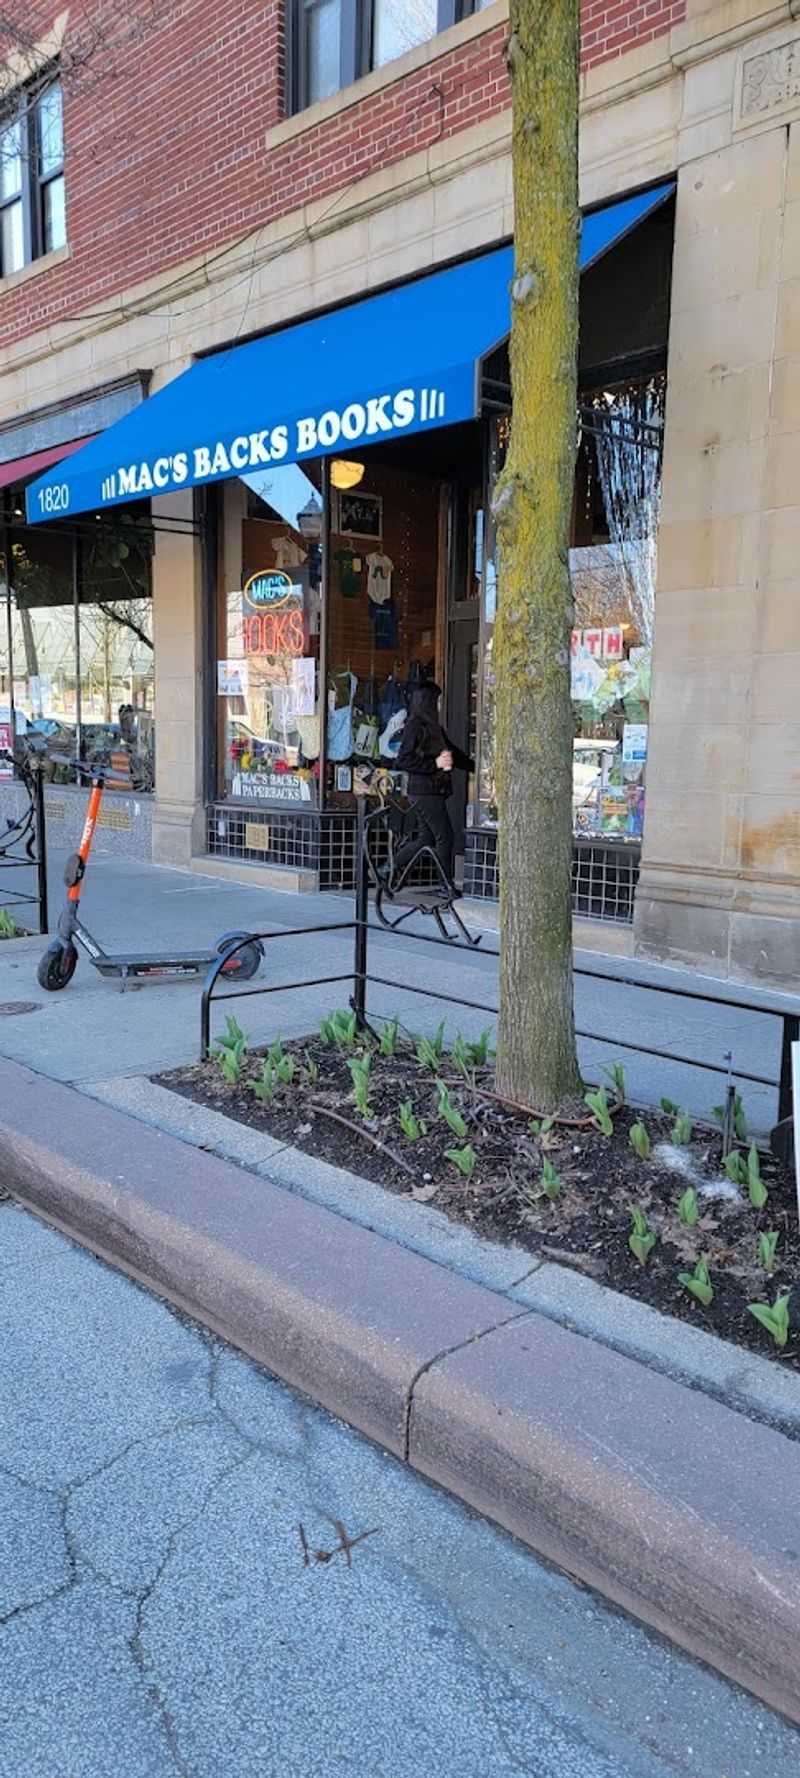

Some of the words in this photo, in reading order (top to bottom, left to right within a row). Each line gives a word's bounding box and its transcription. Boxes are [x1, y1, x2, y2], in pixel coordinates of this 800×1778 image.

[118, 452, 188, 496] MAC'S
[193, 423, 289, 479] BACKS
[296, 388, 416, 454] BOOKS
[38, 483, 70, 513] 1820
[241, 784, 301, 801] PAPERBACKS
